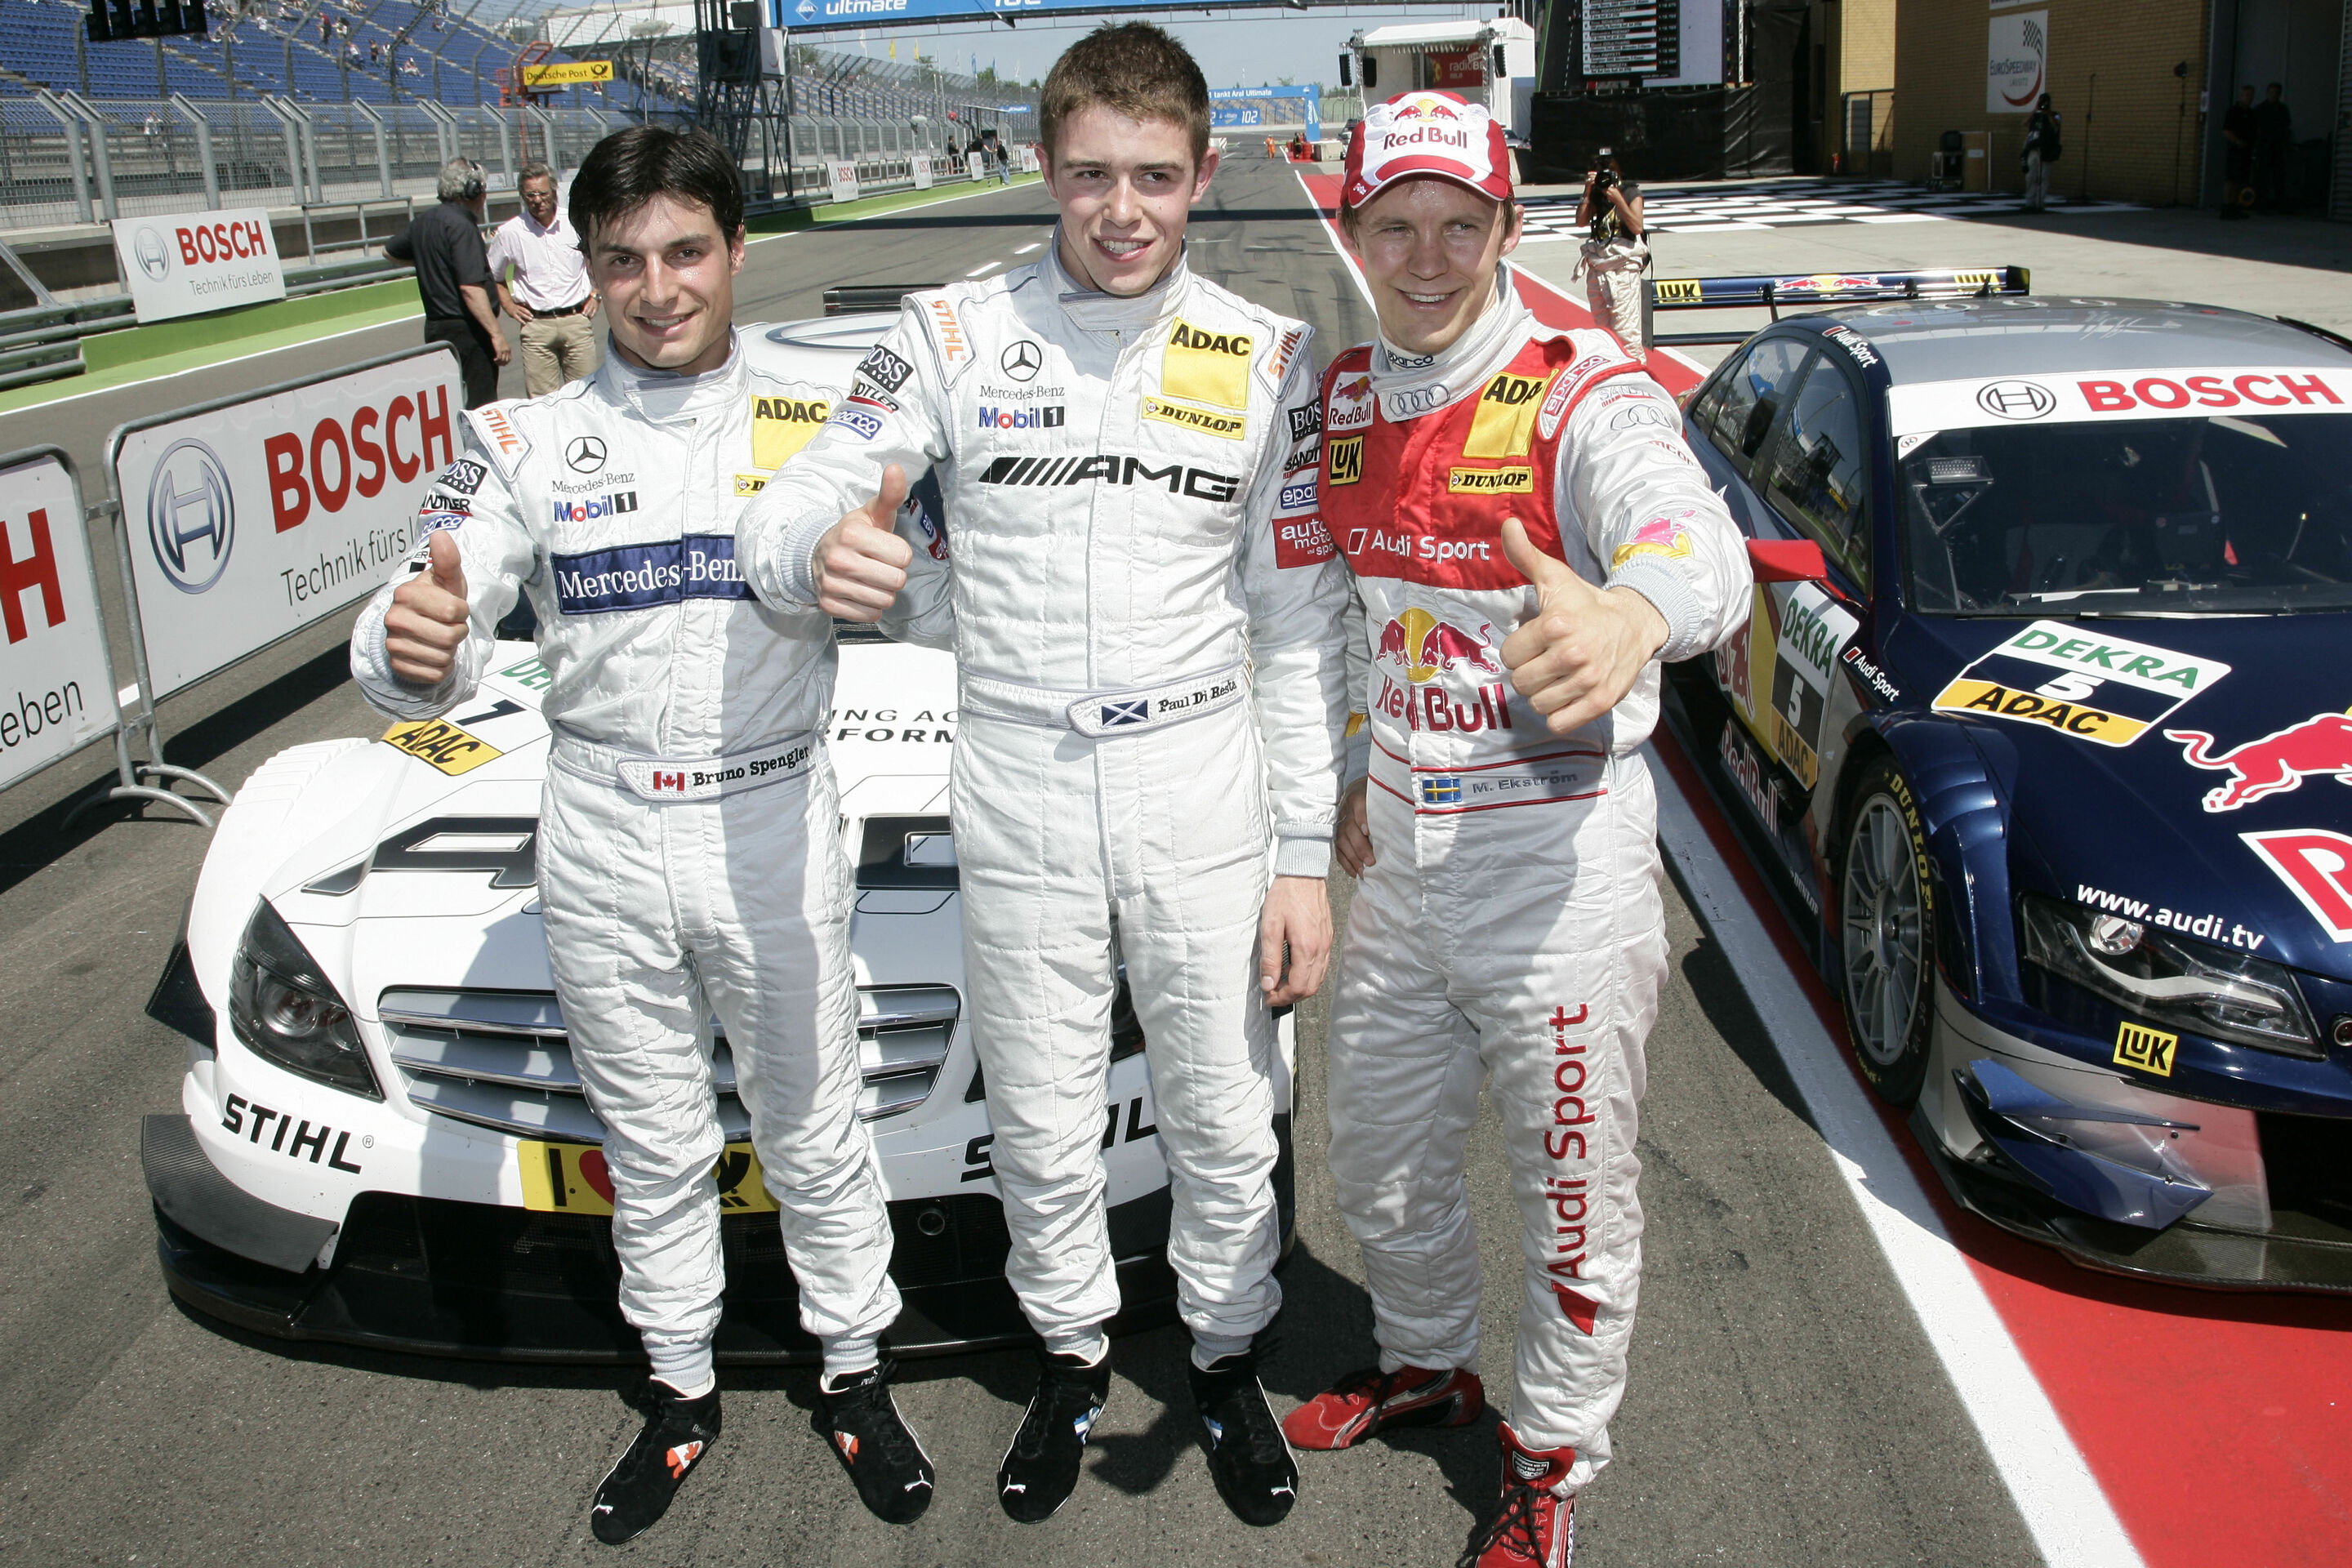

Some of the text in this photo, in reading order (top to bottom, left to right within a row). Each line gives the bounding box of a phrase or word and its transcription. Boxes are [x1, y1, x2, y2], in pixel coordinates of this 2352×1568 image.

[568, 69, 588, 78] Post
[1241, 111, 1258, 123] 102
[1383, 127, 1467, 150] Red Bull
[176, 220, 268, 265] BOSCH
[189, 270, 274, 296] Technik fürs Leben
[928, 300, 964, 361] STIHL
[1171, 324, 1250, 357] ADAC
[1267, 328, 1303, 380] STIHL
[1833, 330, 1878, 368] Audi Sport
[979, 384, 1066, 401] Mercedes-Benz
[1483, 375, 1543, 407] ADA
[2077, 374, 2345, 412] BOSCH
[755, 398, 828, 424] ADAC
[831, 410, 879, 434] parco
[979, 407, 1040, 429] Mobil
[1159, 407, 1242, 433] DUNLOP
[1293, 400, 1322, 432] BOS
[1329, 400, 1371, 426] Red Bull
[479, 408, 519, 455] STIHL
[264, 384, 454, 533] BOSCH
[444, 461, 483, 488] OSS
[1284, 448, 1320, 471] SANDT
[552, 472, 635, 495] Mercedes-Benz
[1064, 454, 1241, 502] AMG
[1282, 485, 1317, 507] spar
[1462, 471, 1528, 489] DUNLOP
[422, 493, 471, 512] NDTLER
[555, 495, 613, 523] Mobil
[1316, 543, 1335, 556] spo
[1370, 528, 1490, 565] Audi Sport
[280, 523, 407, 608] Technik fürs
[1781, 597, 1839, 679] DEKRA
[1855, 654, 1899, 702] Audi Sport
[2010, 629, 2199, 691] DEKRA
[1158, 679, 1238, 715] Paul Di Resta
[1788, 674, 1803, 728] 5
[2034, 670, 2106, 702] 5
[0, 679, 83, 748] eben
[1423, 683, 1512, 733] Bull
[1966, 686, 2110, 735] ADAC
[390, 724, 481, 764] ADAC
[1777, 719, 1809, 785] ADAC
[693, 745, 809, 786] Bruno Spengler
[1472, 769, 1578, 795] M. Ekström
[1889, 773, 1934, 911] DUNLOP
[2077, 884, 2265, 951] www.audi.tv
[221, 1092, 363, 1176] STIHL
[1544, 1002, 1596, 1283] Audi Sport
